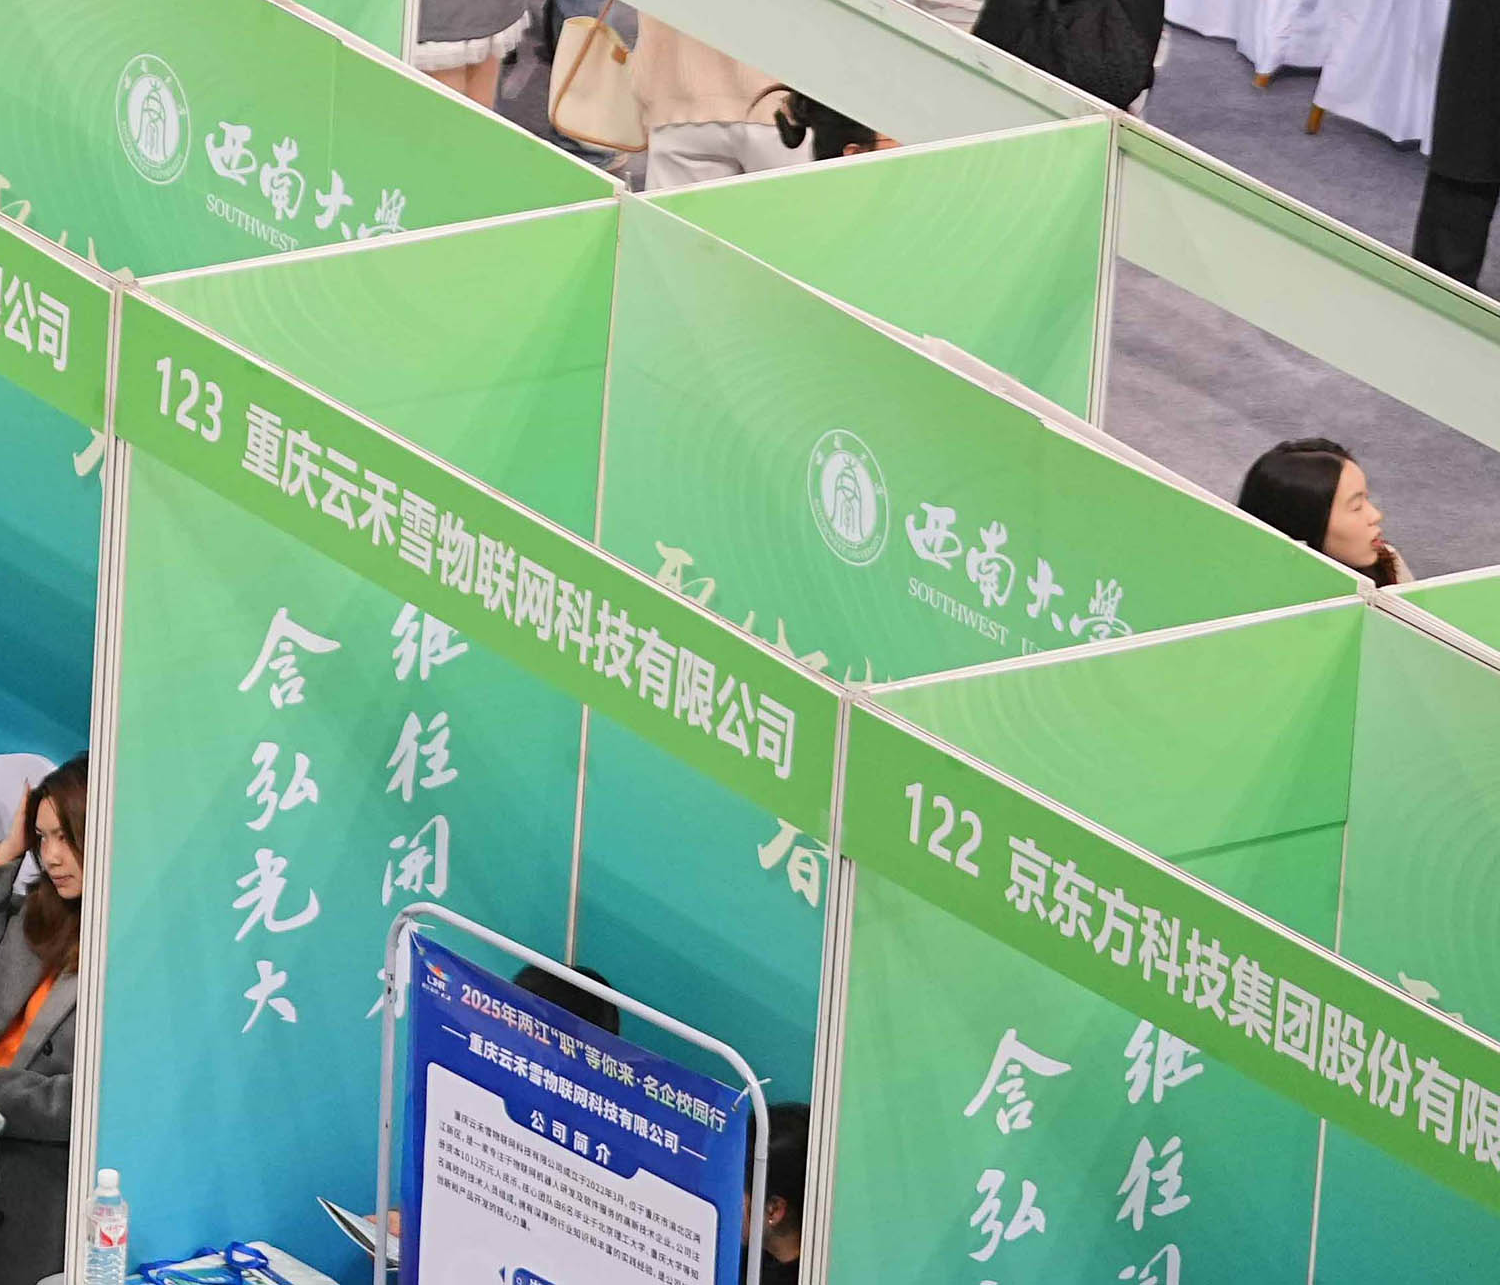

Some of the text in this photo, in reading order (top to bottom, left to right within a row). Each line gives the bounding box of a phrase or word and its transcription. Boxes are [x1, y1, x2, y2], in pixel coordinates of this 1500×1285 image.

[157, 357, 796, 779] 123 重庆云禾雪物联网科技有限公司
[909, 578, 1010, 646] SOUTHWEST
[233, 611, 338, 1034] 含弘光大
[468, 1033, 679, 1153] 重庆云禾雪物联网科技有限公司
[905, 783, 1500, 1173] 122 京东方科技集团股份有限
[531, 1110, 612, 1165] 公司简介
